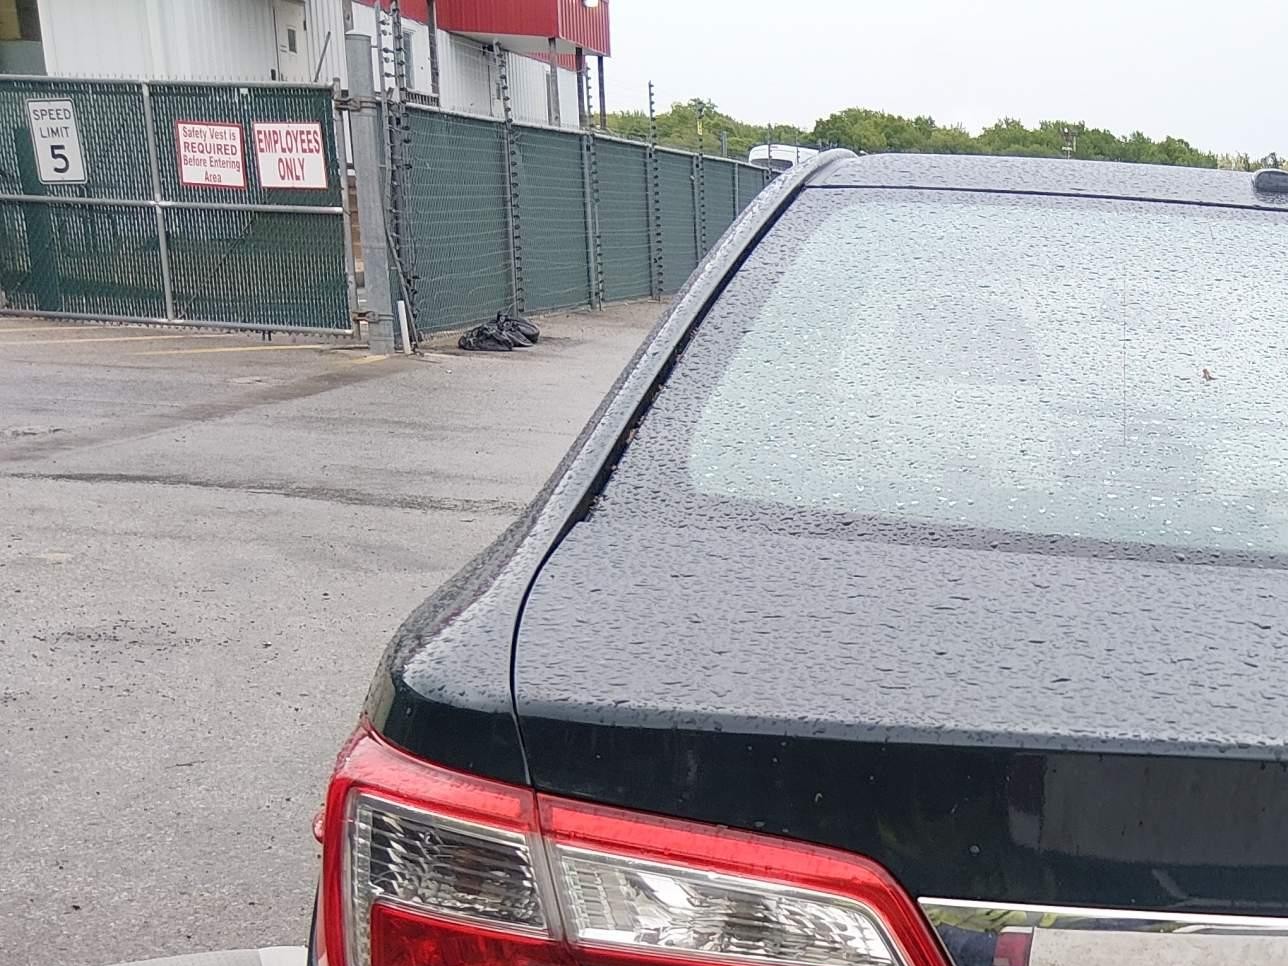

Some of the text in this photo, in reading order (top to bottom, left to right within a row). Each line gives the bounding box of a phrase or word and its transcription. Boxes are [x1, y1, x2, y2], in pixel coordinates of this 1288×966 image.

[33, 108, 71, 120] SPEED
[40, 126, 69, 138] LIMIT
[183, 126, 207, 142] Safety
[209, 128, 227, 141] Vest
[183, 141, 237, 156] REQUIRED
[257, 130, 320, 154] EMPLOYEES
[50, 145, 69, 173] 5
[183, 154, 240, 172] Before Entering
[205, 171, 222, 183] Area
[278, 158, 305, 180] ONLY
